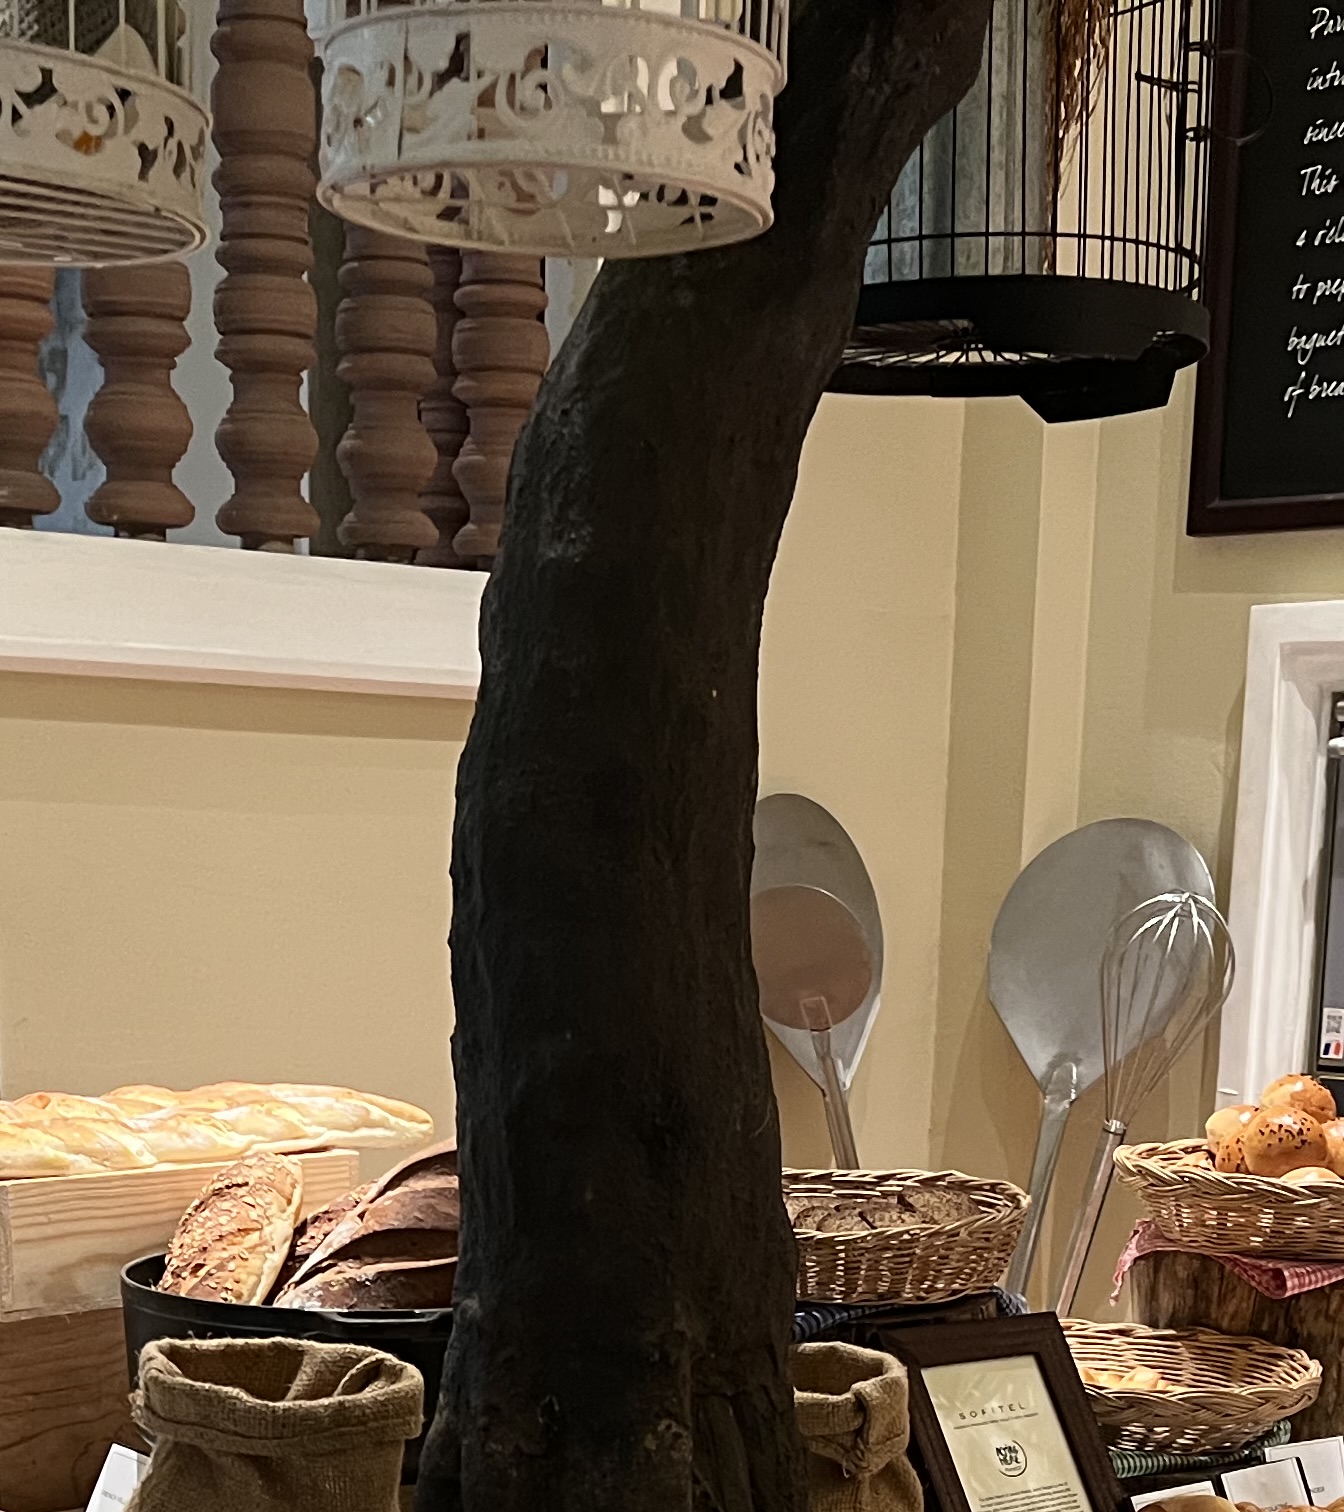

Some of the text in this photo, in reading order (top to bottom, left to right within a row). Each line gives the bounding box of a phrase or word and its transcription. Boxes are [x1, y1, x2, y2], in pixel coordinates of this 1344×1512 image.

[1300, 164, 1339, 196] This
[1291, 273, 1312, 300] to
[1283, 370, 1306, 419] of
[958, 1401, 1027, 1421] SOFITEL
